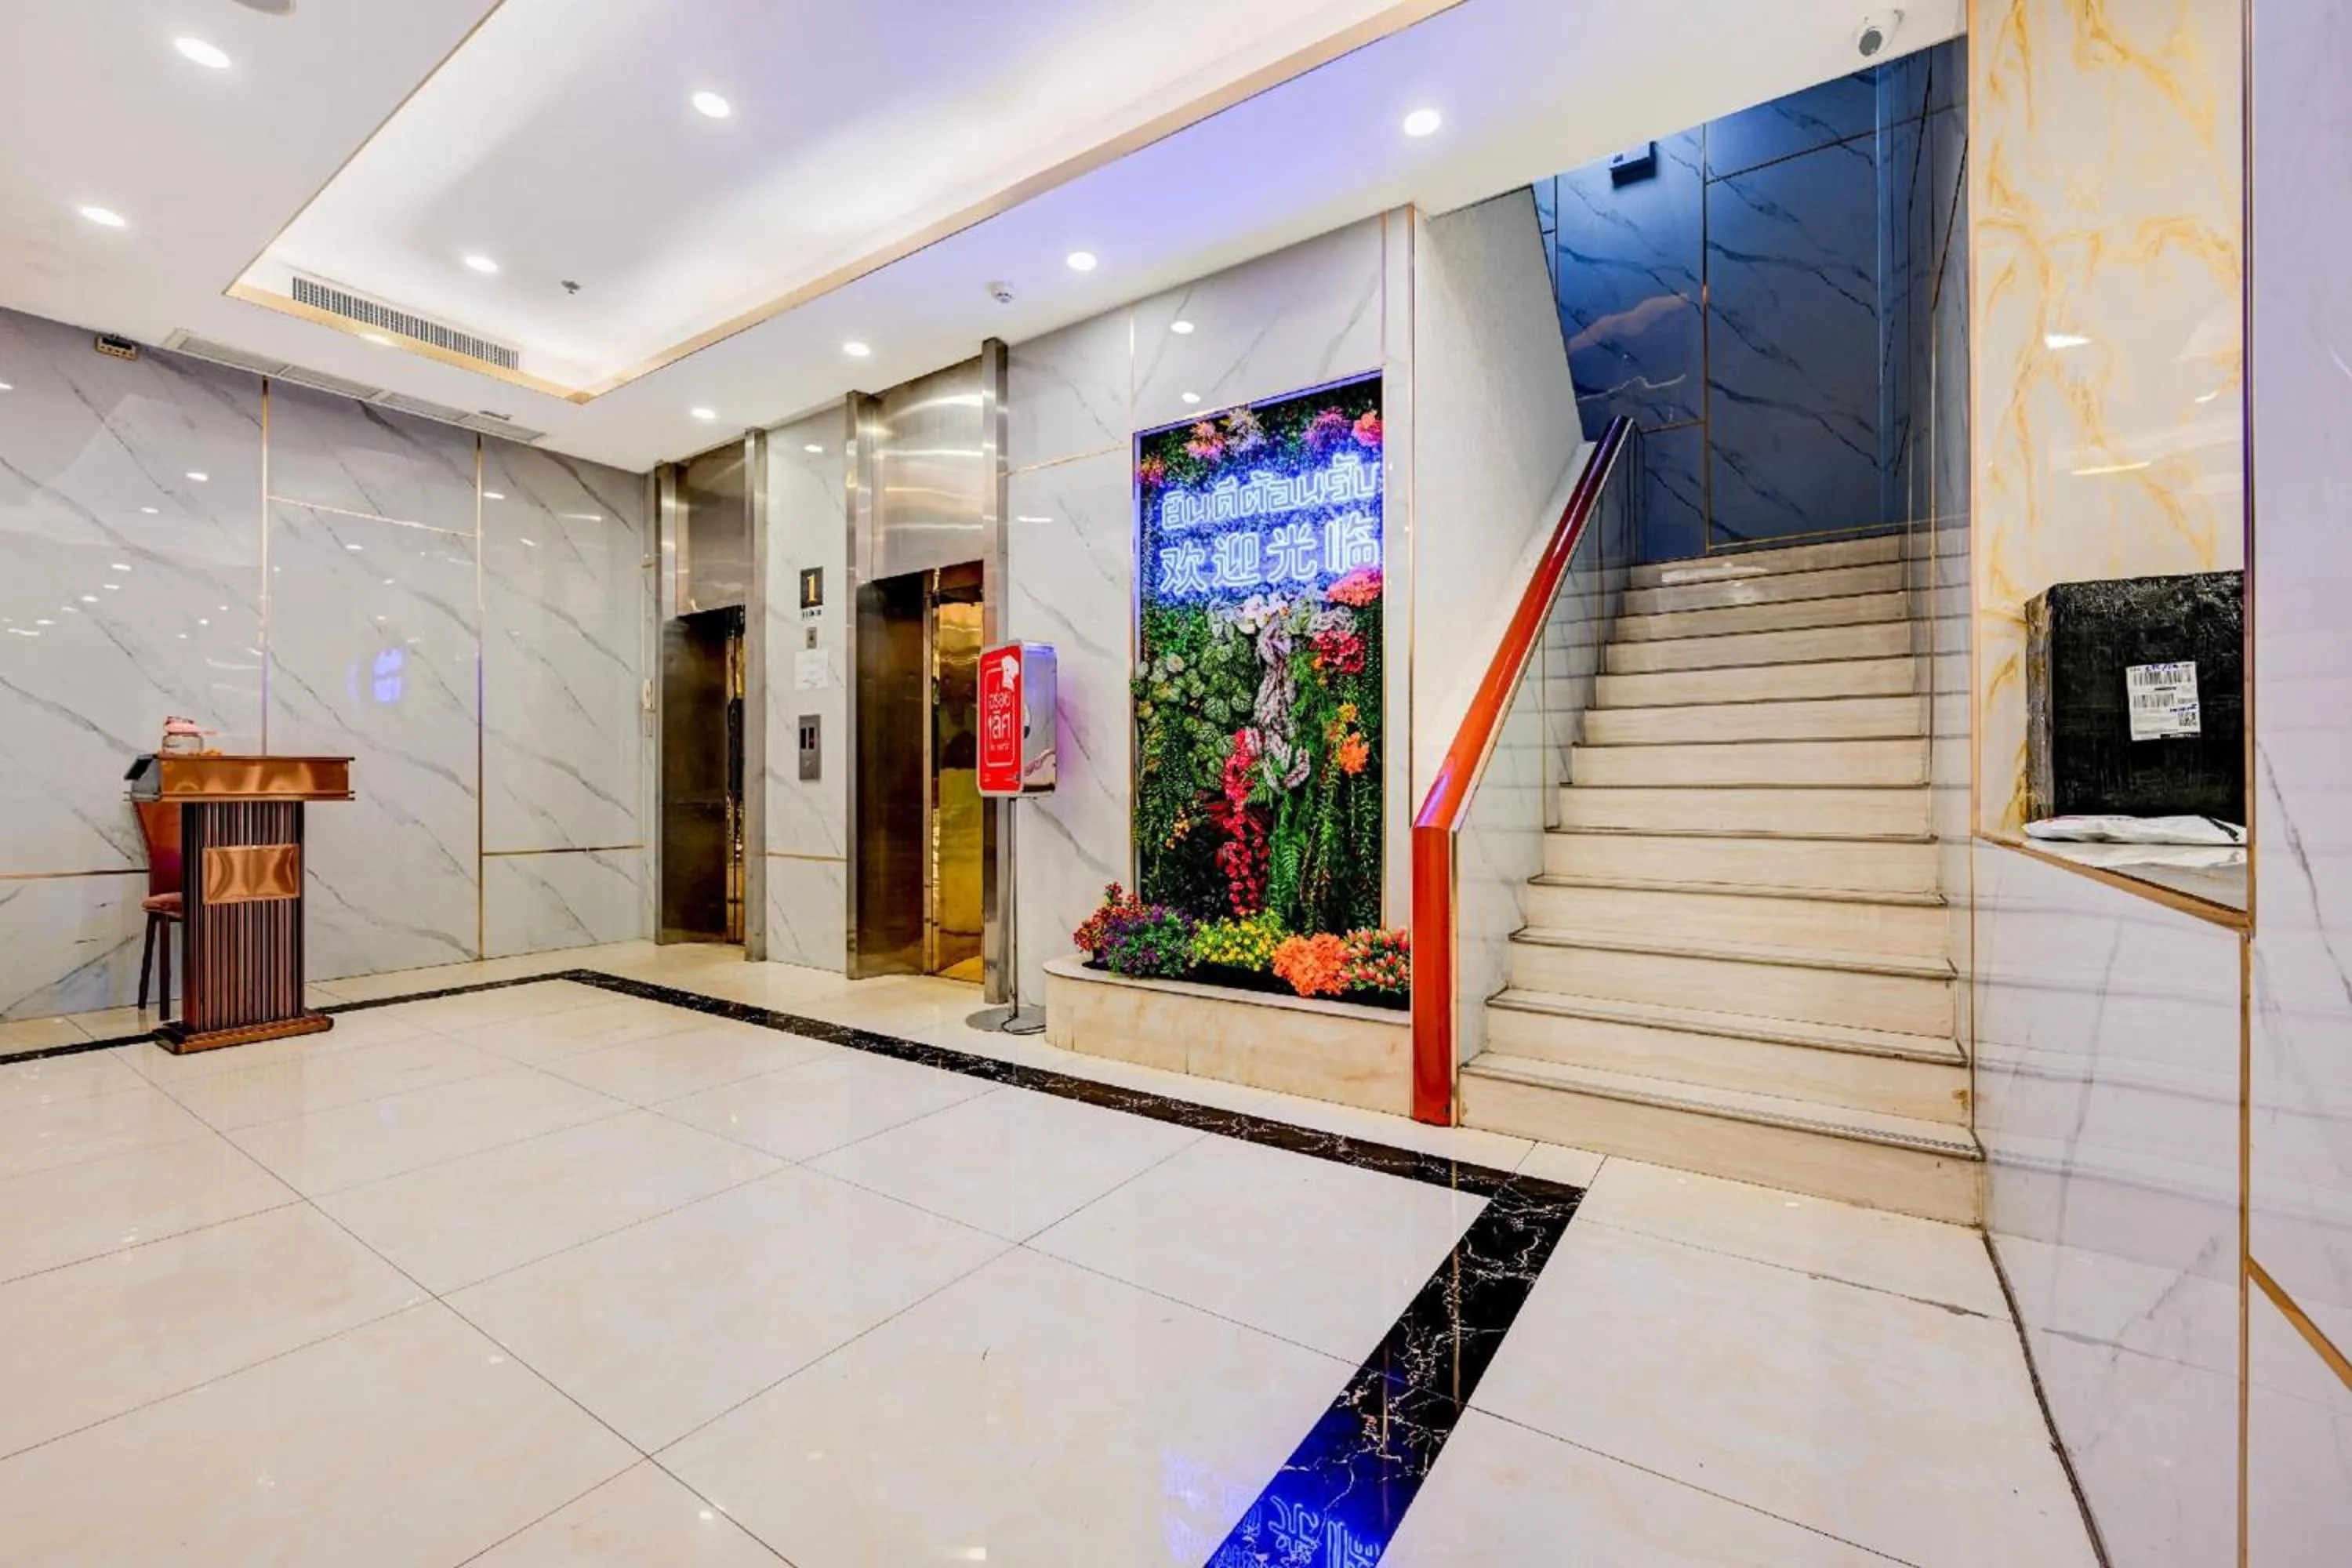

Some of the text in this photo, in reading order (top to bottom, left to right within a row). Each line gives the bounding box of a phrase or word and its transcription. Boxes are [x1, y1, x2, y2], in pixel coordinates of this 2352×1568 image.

[1162, 453, 1380, 530] ยินดีต้อนรับ
[808, 574, 817, 603] 1
[1160, 514, 1379, 594] 欢迎光临
